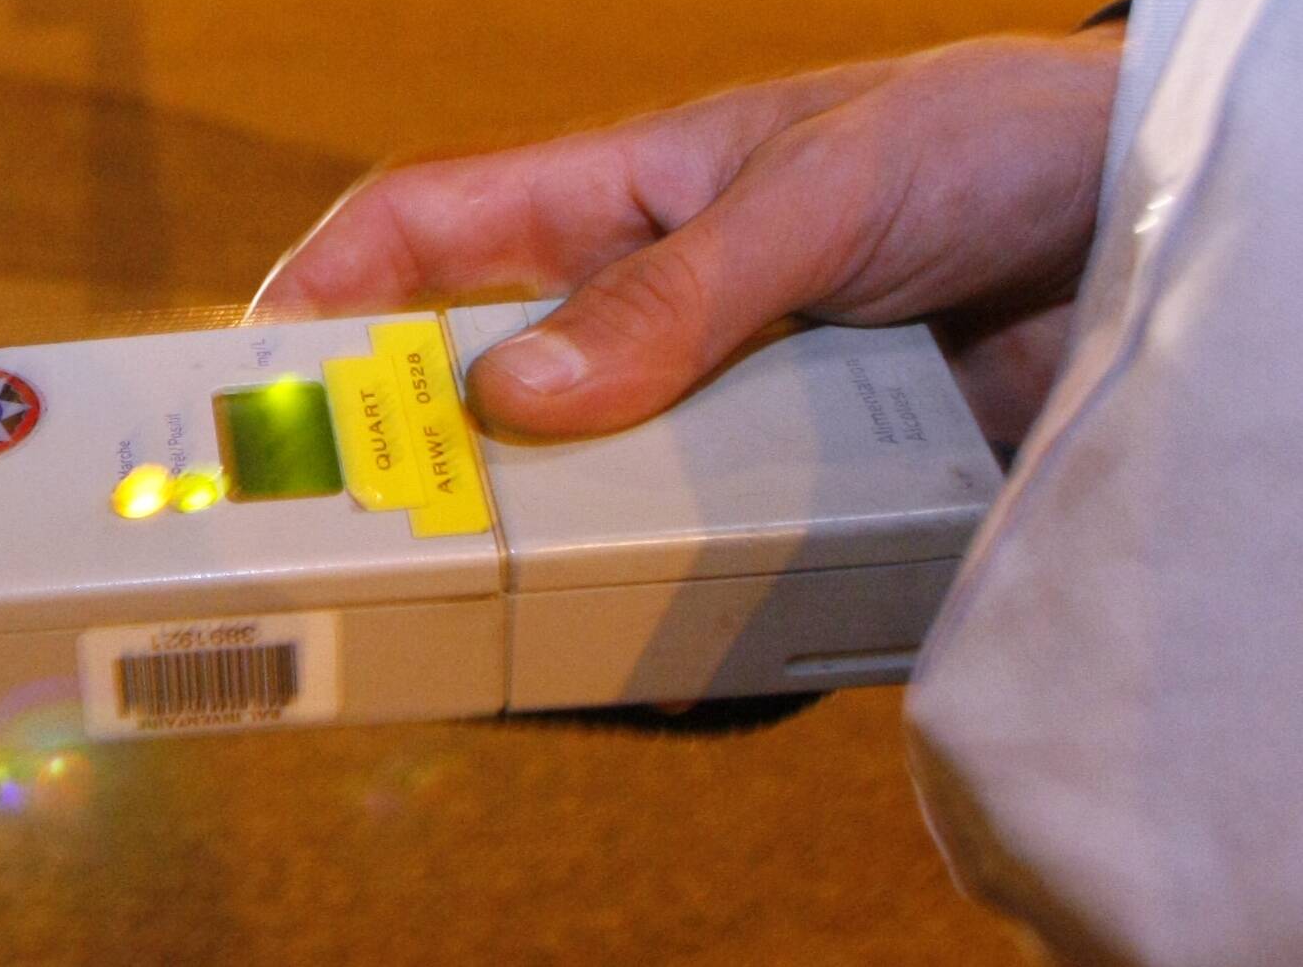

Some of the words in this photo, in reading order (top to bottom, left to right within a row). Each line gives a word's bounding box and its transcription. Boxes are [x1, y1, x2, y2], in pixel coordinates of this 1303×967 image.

[407, 352, 431, 404] 0528
[845, 358, 900, 445] Alimentation
[360, 389, 392, 471] QUART
[423, 425, 454, 495] ARWF
